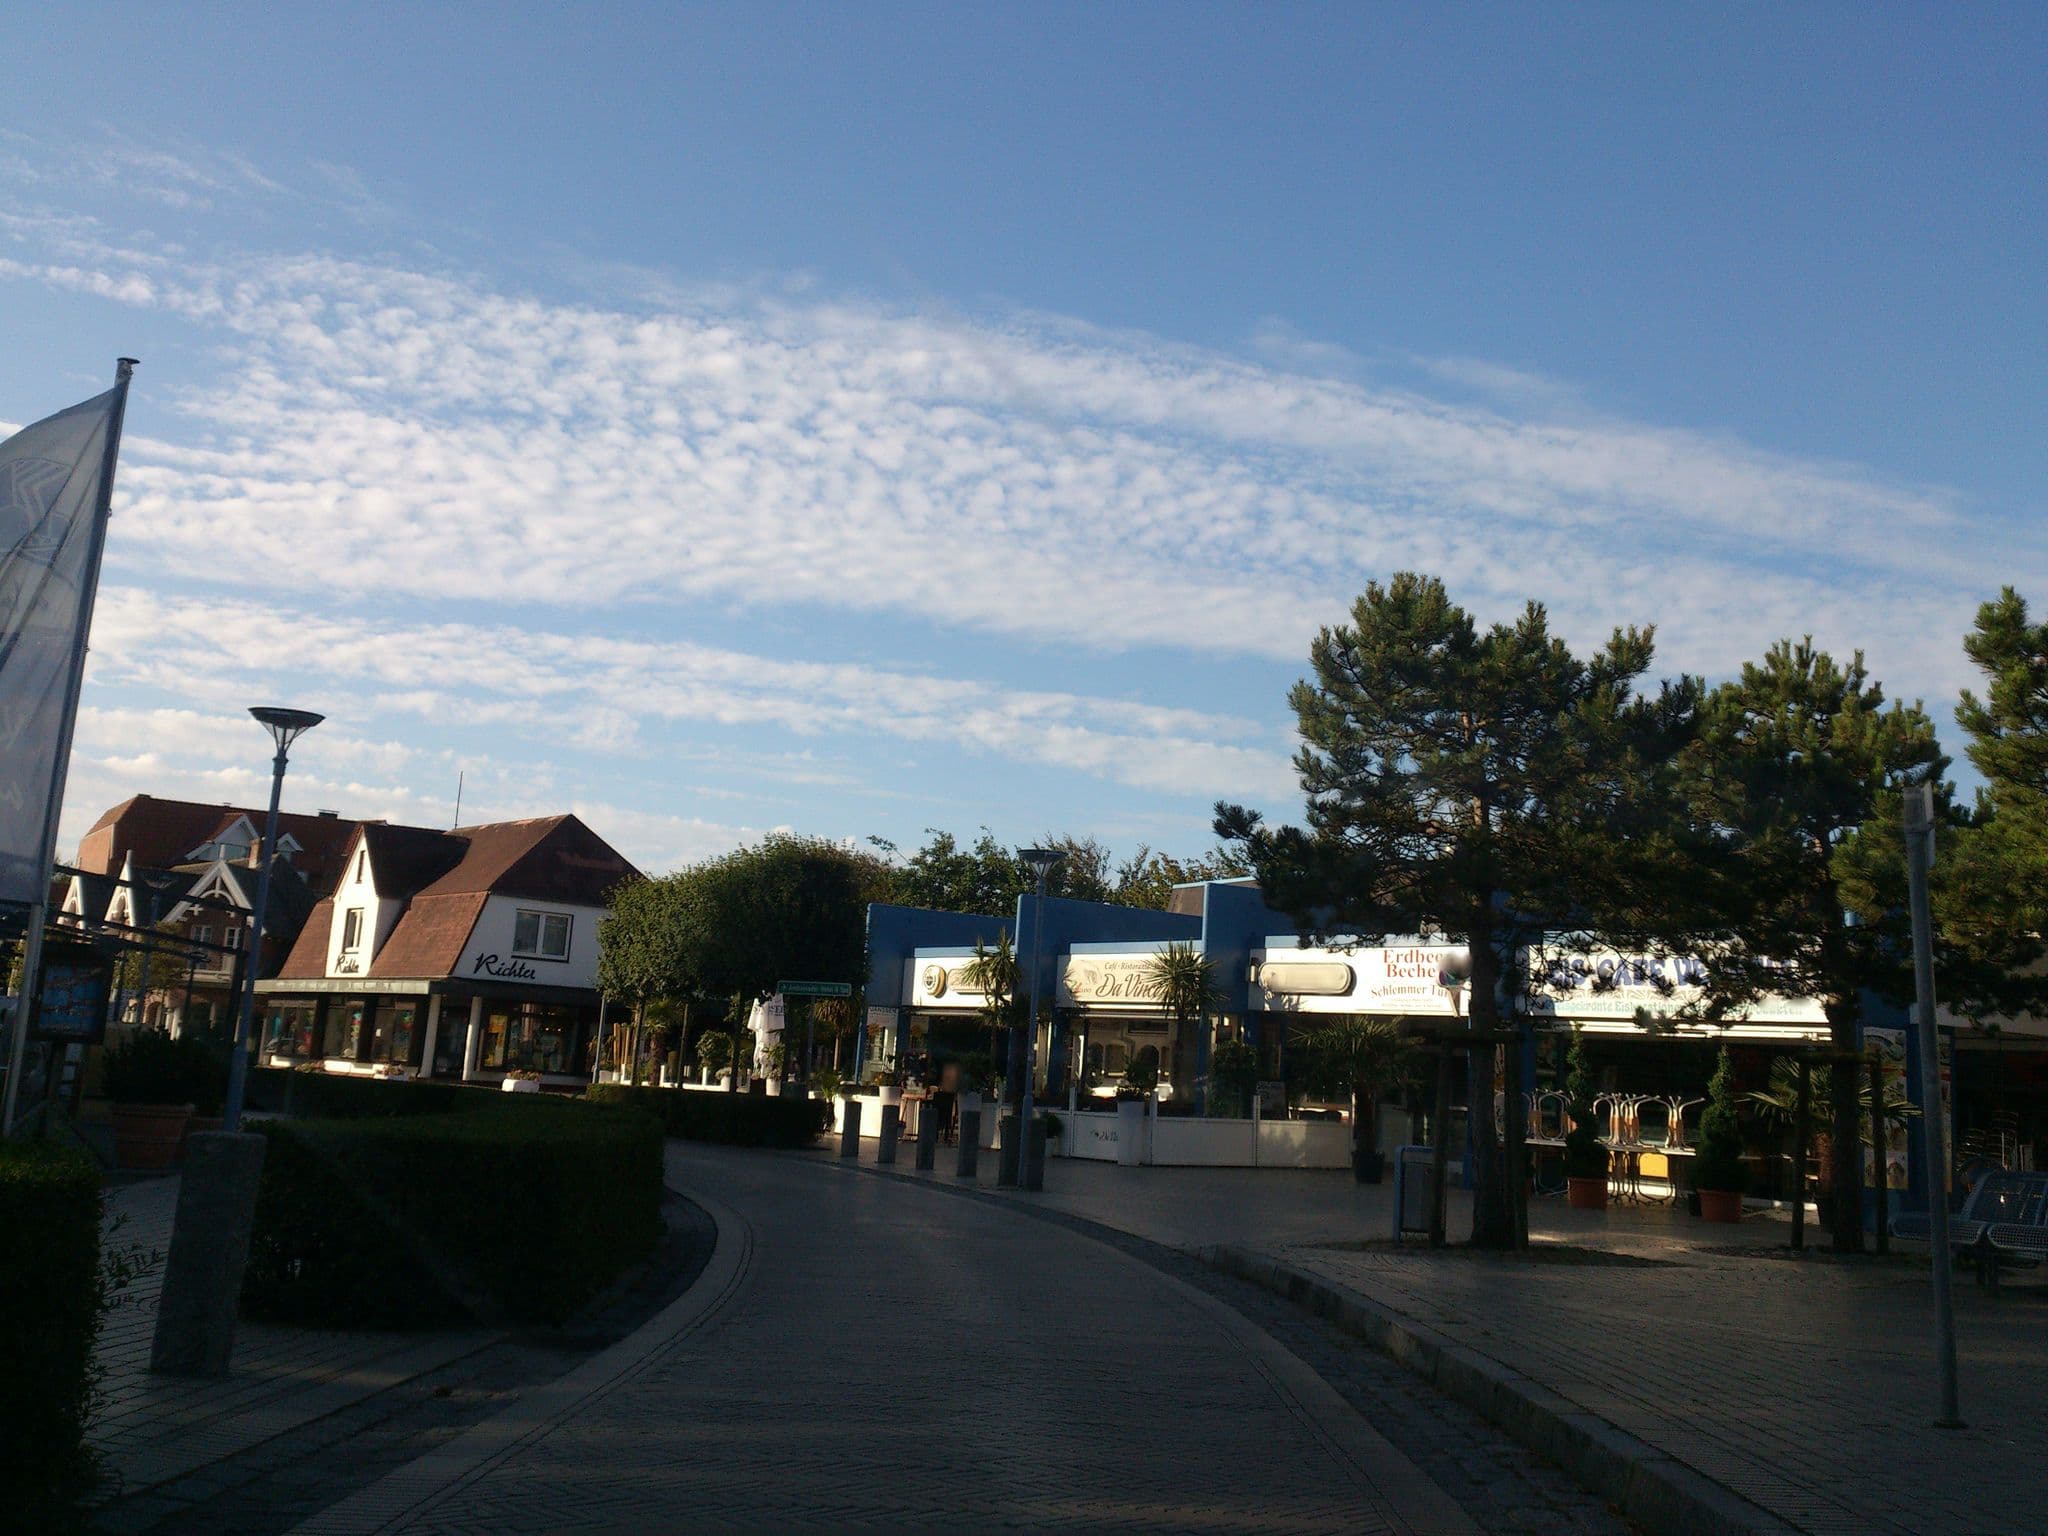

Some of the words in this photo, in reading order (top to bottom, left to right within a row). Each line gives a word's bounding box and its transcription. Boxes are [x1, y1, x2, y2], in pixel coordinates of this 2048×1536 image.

[1383, 949, 1446, 964] Erdbee
[473, 953, 536, 979] Richter
[1386, 964, 1438, 978] Beche
[1095, 973, 1123, 998] Da
[1371, 984, 1426, 999] Schlemmer
